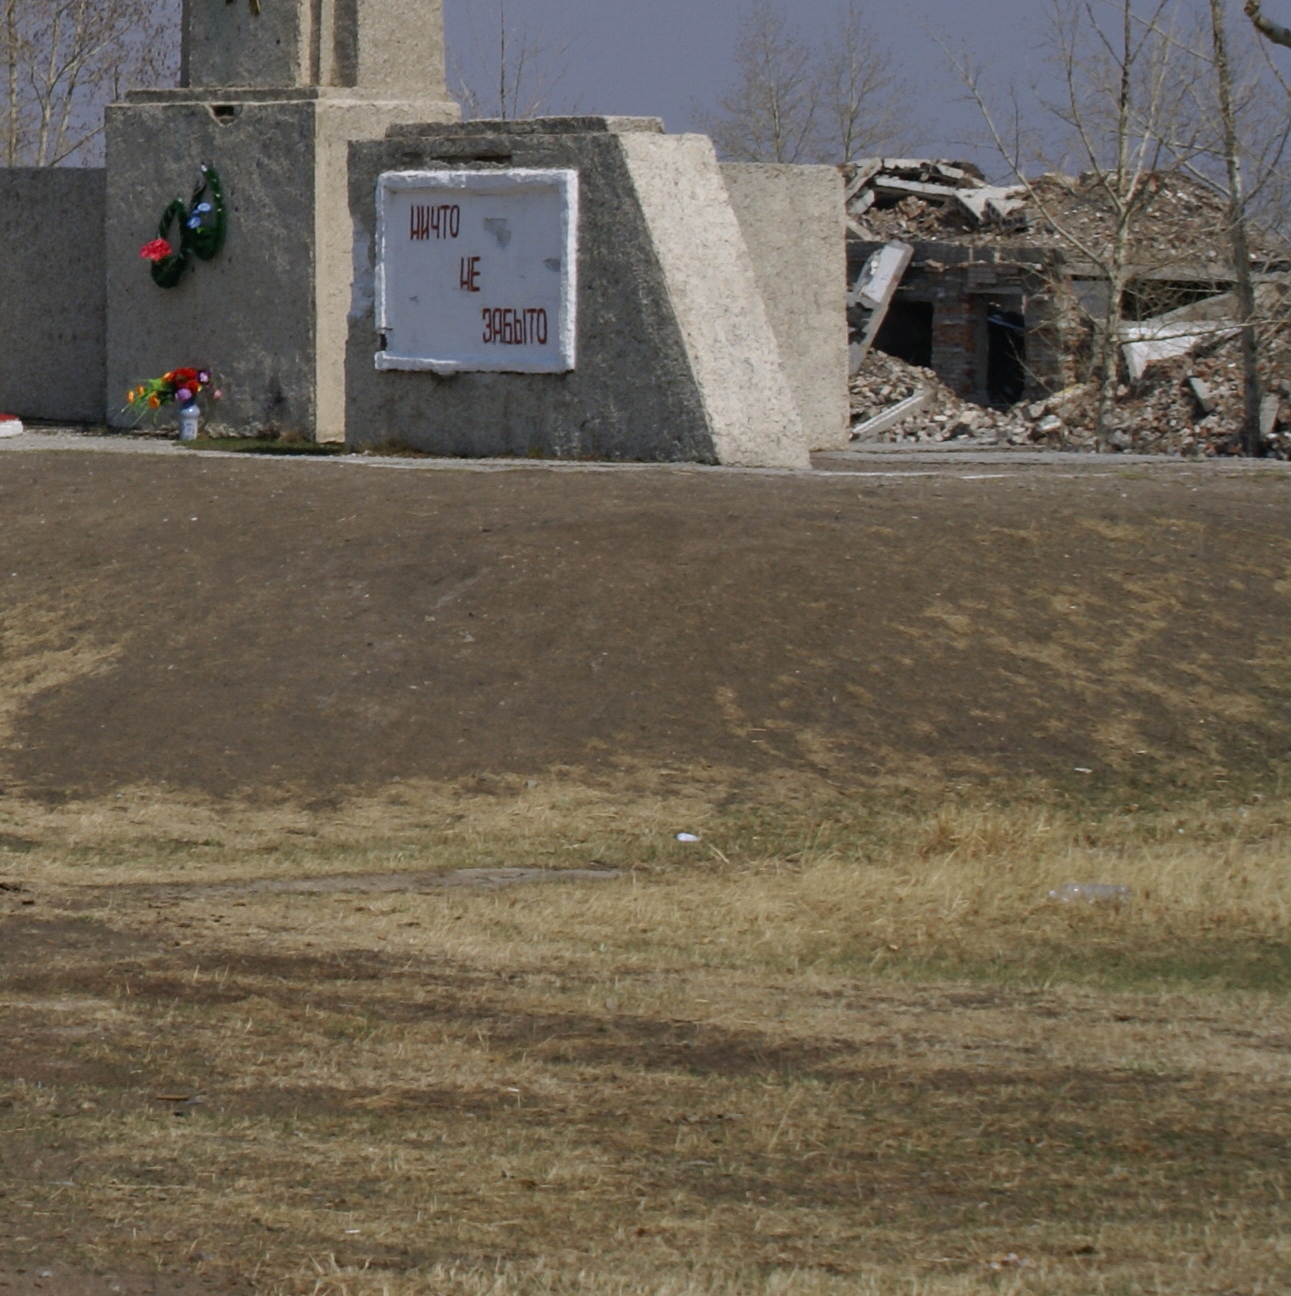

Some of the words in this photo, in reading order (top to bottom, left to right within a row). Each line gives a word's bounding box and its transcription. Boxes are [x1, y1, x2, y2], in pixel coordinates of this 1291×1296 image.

[410, 204, 460, 240] НИЧТО
[459, 256, 481, 292] НЕ
[482, 308, 548, 345] ЗАБЫТО
